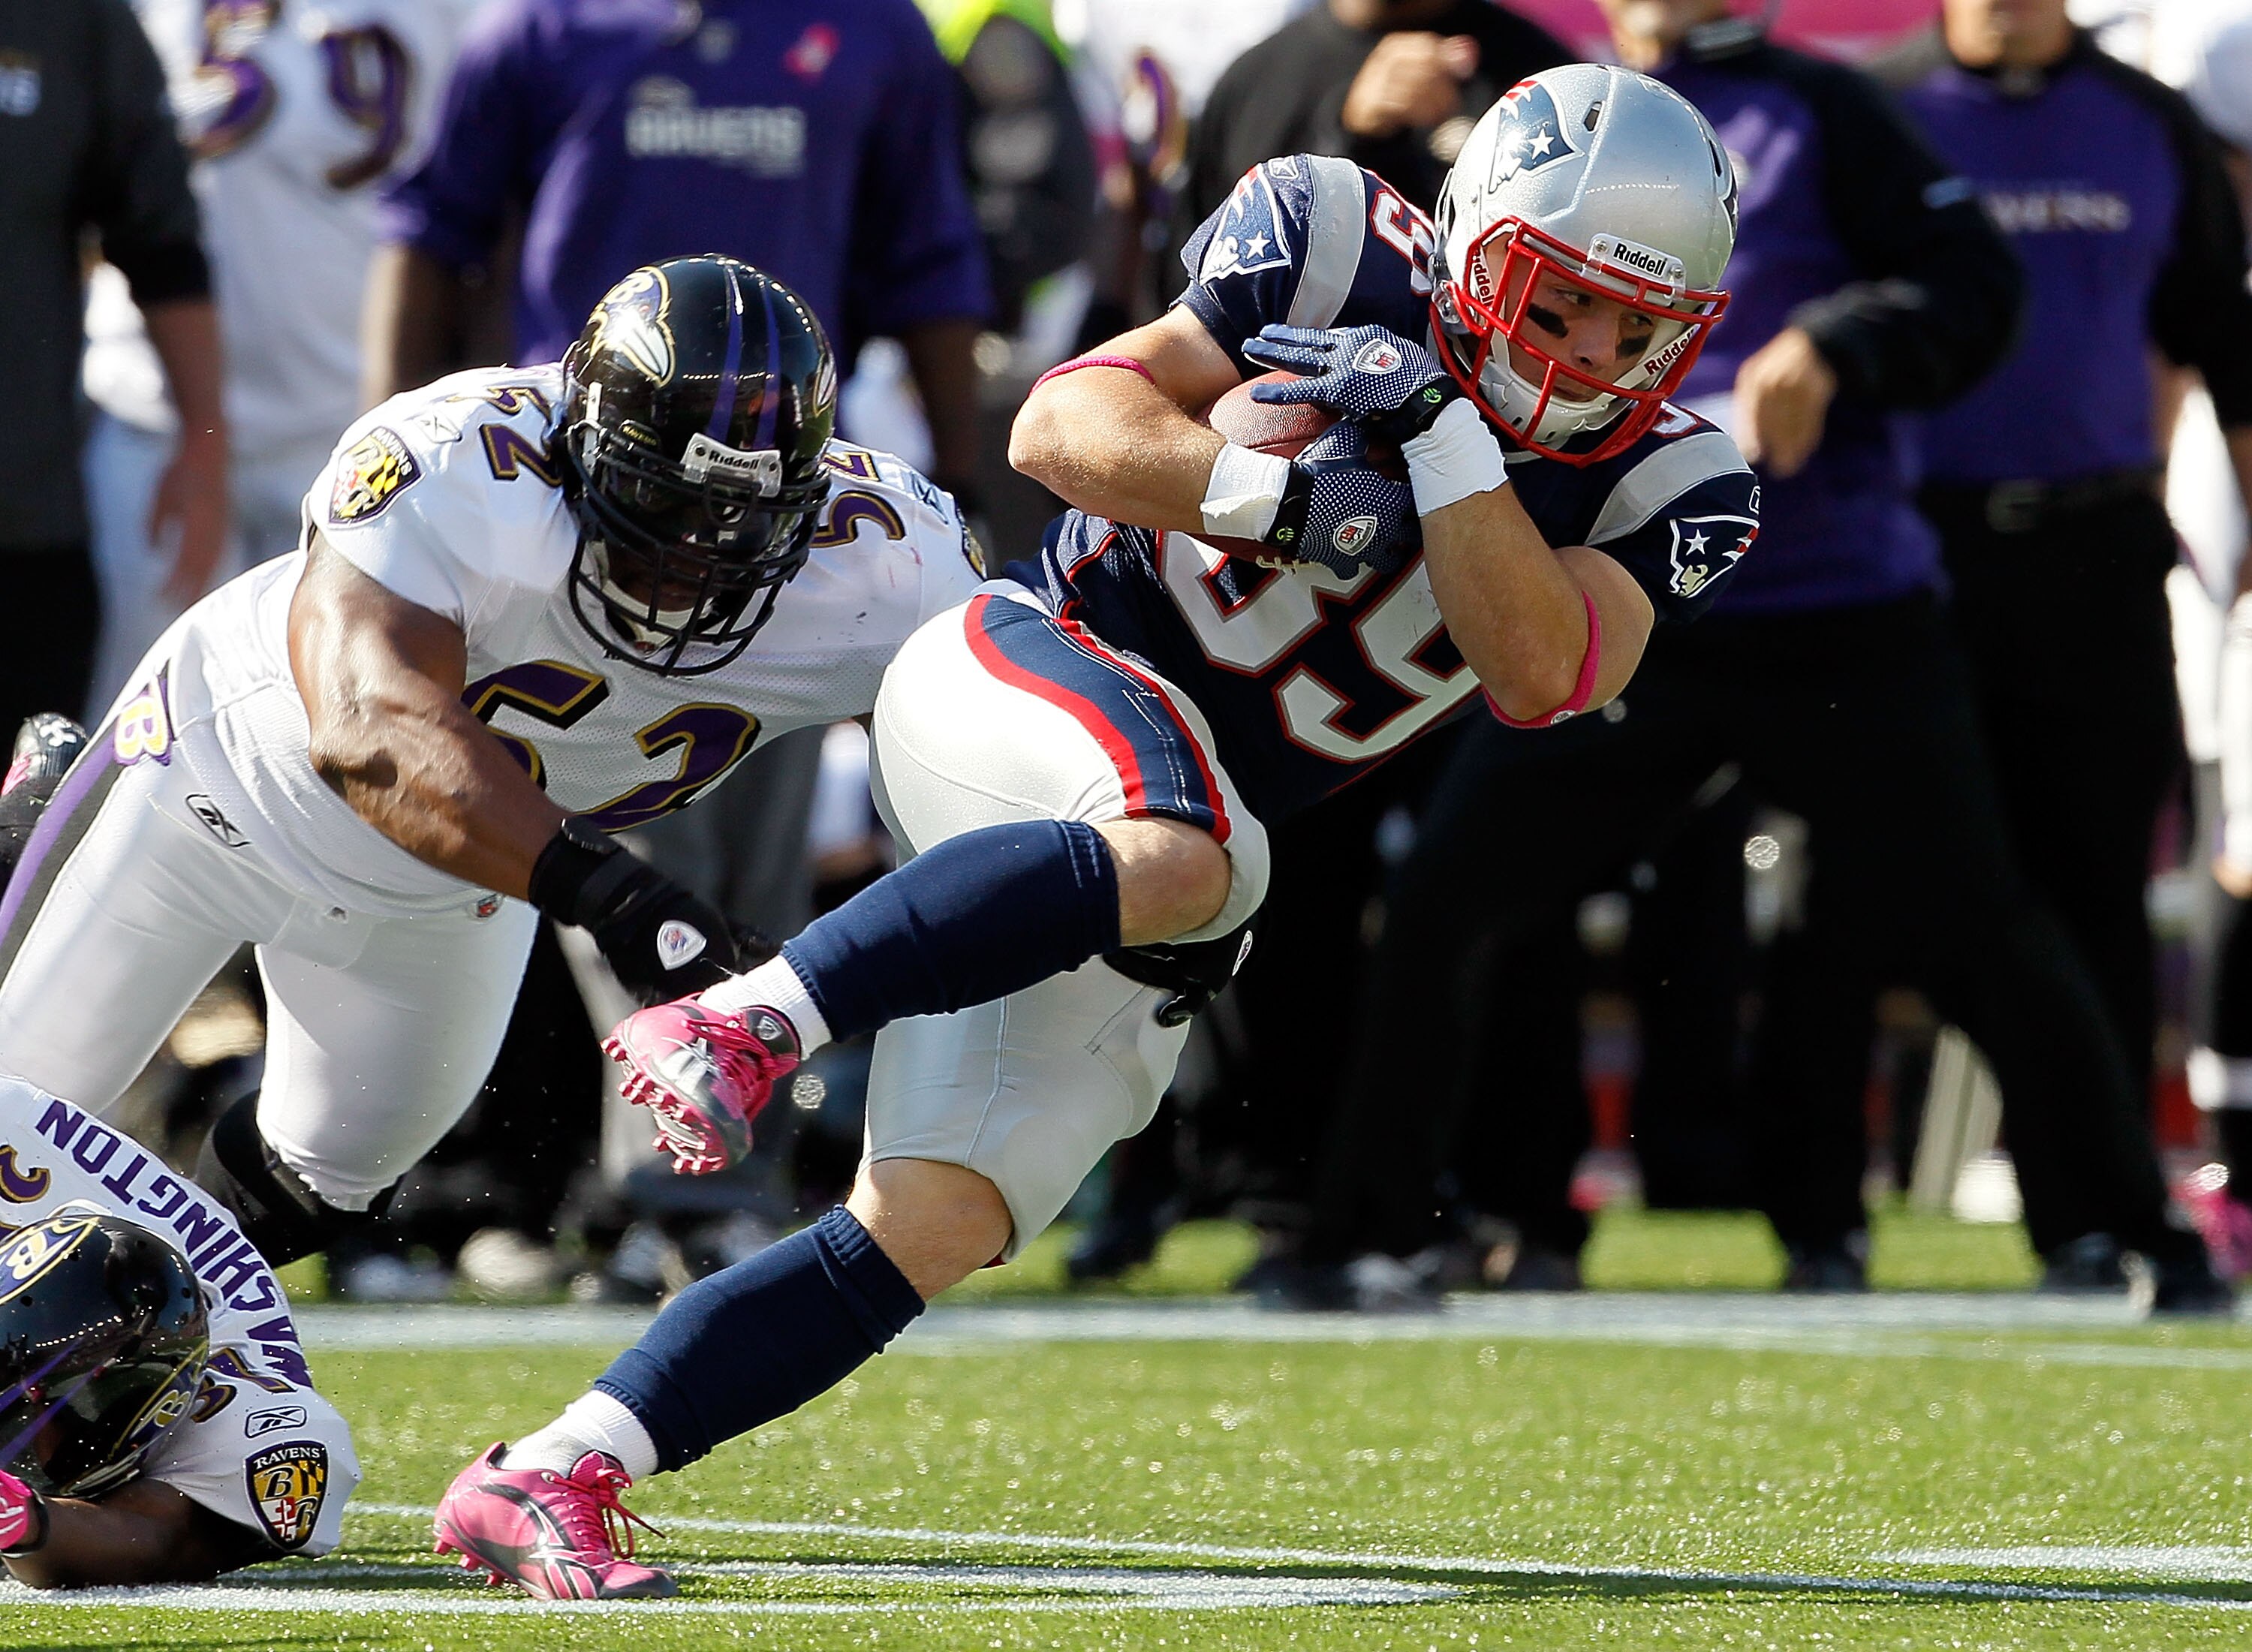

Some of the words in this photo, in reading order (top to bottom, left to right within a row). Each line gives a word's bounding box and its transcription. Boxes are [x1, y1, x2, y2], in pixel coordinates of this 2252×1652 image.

[1612, 242, 1668, 276] Riddell
[709, 450, 767, 470] Riddell
[35, 1098, 314, 1390] WASHINGTON
[253, 1447, 321, 1470] RAVENS
[260, 1465, 296, 1500] B
